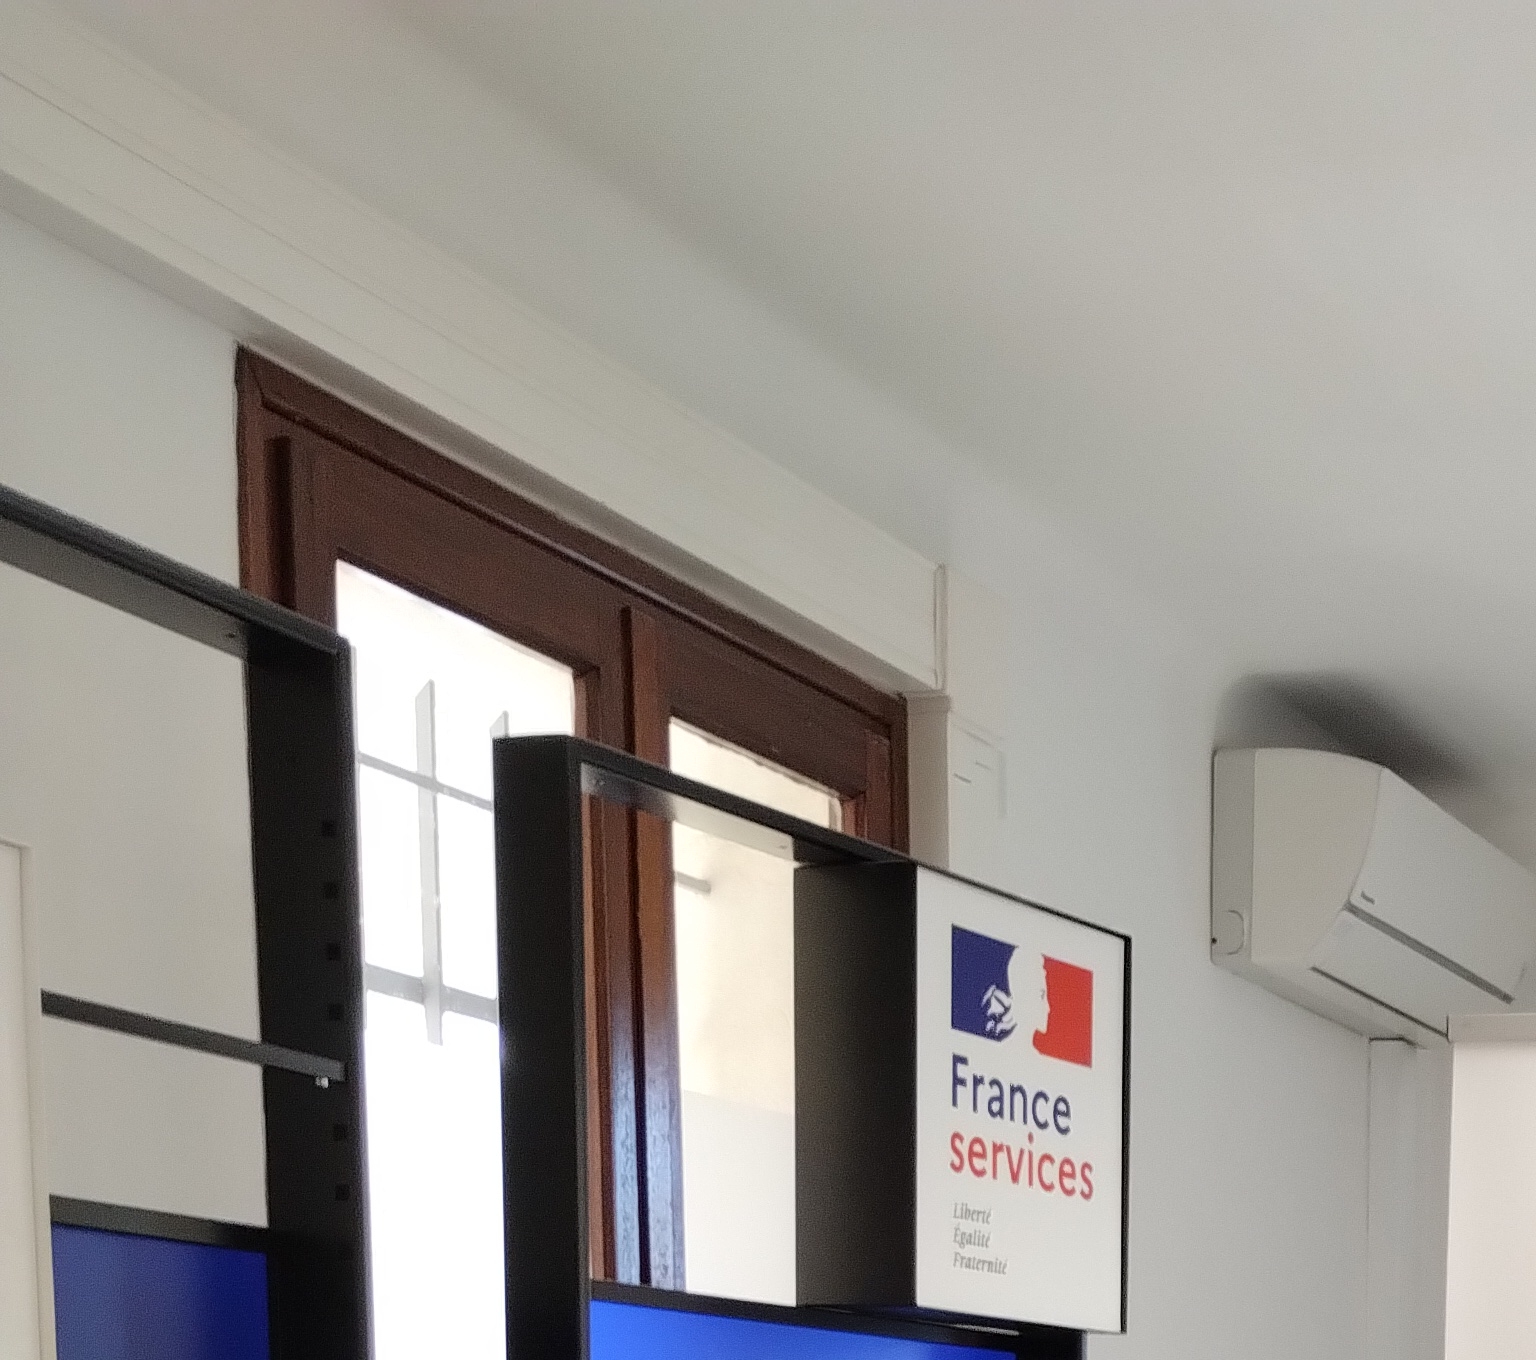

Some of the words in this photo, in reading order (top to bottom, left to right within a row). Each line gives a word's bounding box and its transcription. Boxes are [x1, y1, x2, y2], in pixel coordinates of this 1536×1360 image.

[952, 1053, 1072, 1135] France
[950, 1131, 1094, 1201] services
[953, 1202, 992, 1225] Liberté
[953, 1223, 991, 1249] Égalité
[953, 1251, 1008, 1276] Fraternité
